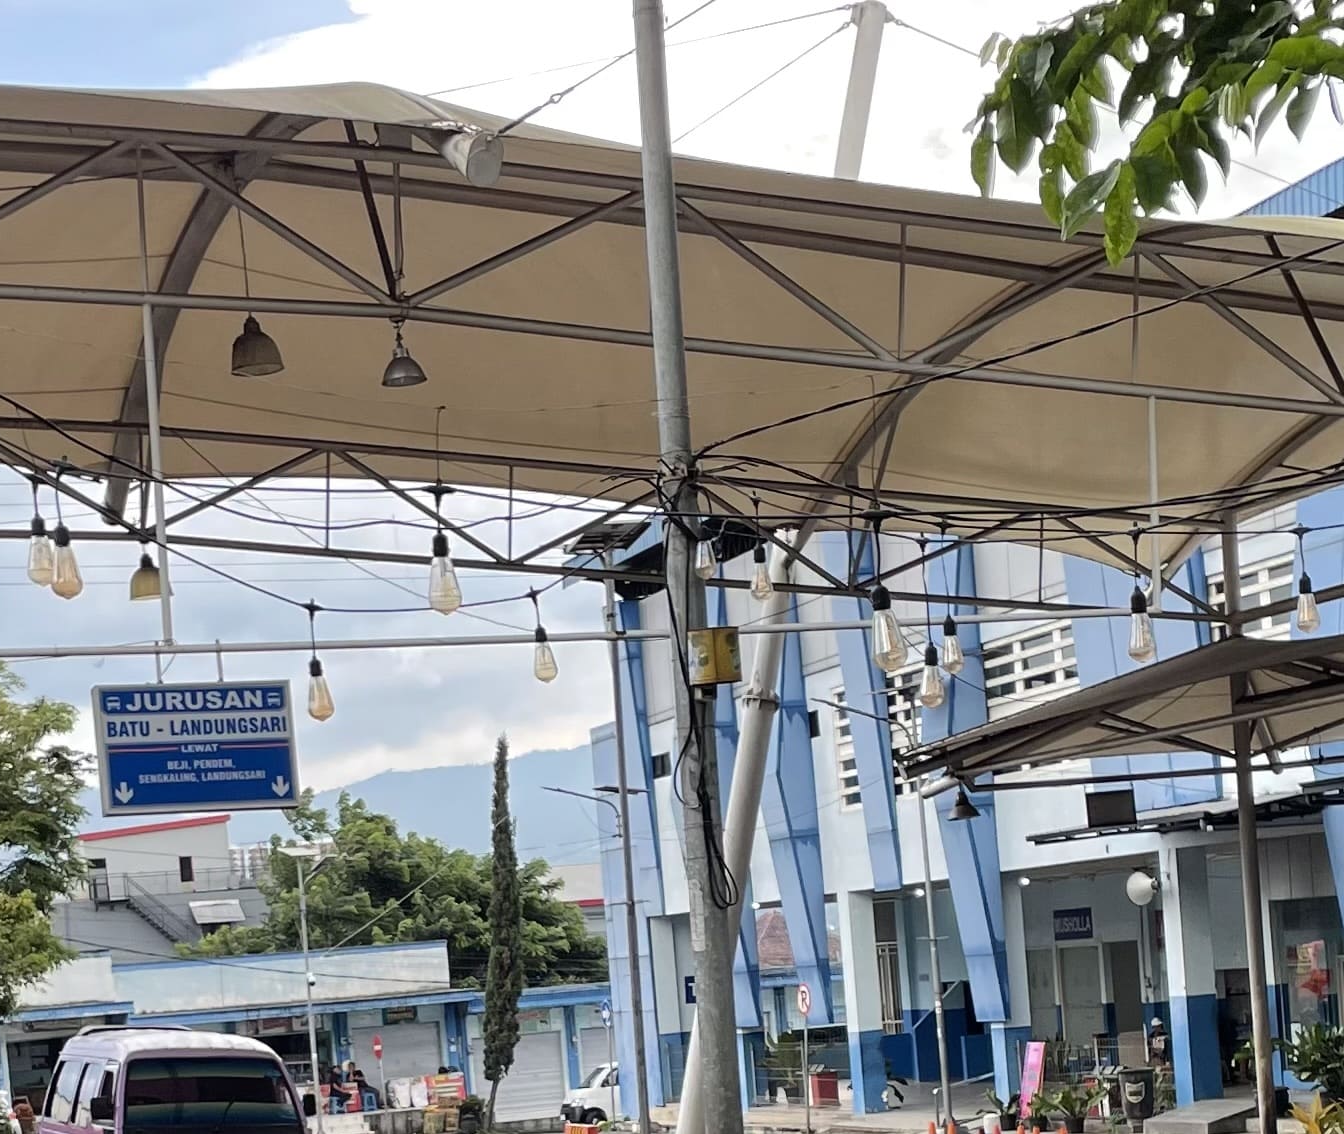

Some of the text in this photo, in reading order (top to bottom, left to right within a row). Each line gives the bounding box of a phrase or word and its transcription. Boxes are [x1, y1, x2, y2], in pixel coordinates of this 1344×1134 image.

[126, 689, 264, 712] JURUSAN
[107, 720, 149, 737] BATU
[170, 716, 287, 736] LANDUNGSARI
[180, 743, 219, 753] LEWAT
